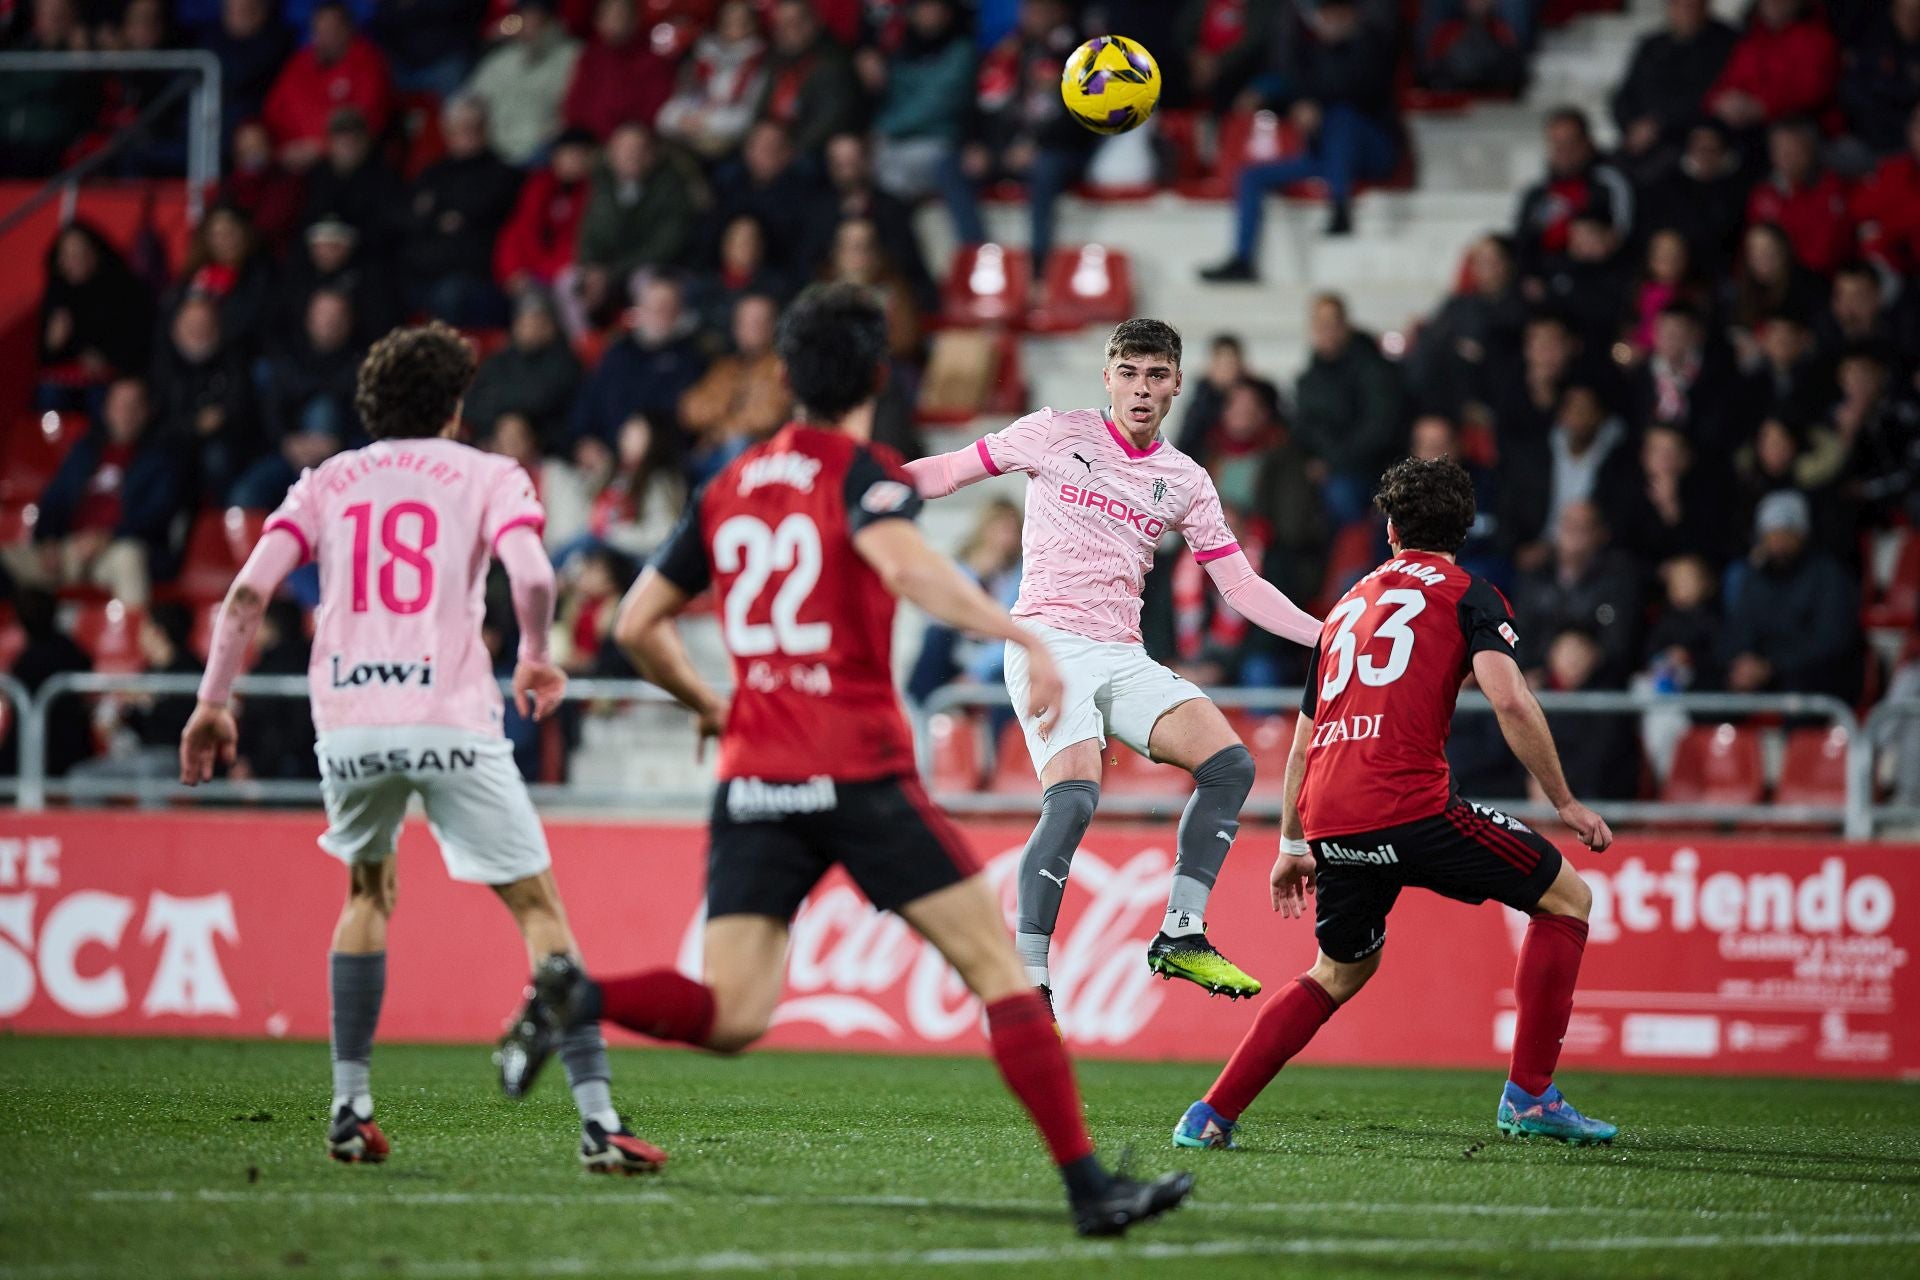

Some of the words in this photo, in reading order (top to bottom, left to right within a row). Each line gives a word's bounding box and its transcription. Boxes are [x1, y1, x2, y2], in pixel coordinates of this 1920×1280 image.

[1059, 484, 1165, 540] SIROKO
[342, 501, 438, 617] 18
[713, 514, 832, 657] 22
[333, 656, 431, 688] Lowi
[1320, 588, 1426, 702] 33
[327, 747, 476, 780] NISSAN
[1320, 841, 1399, 865] Alucoil
